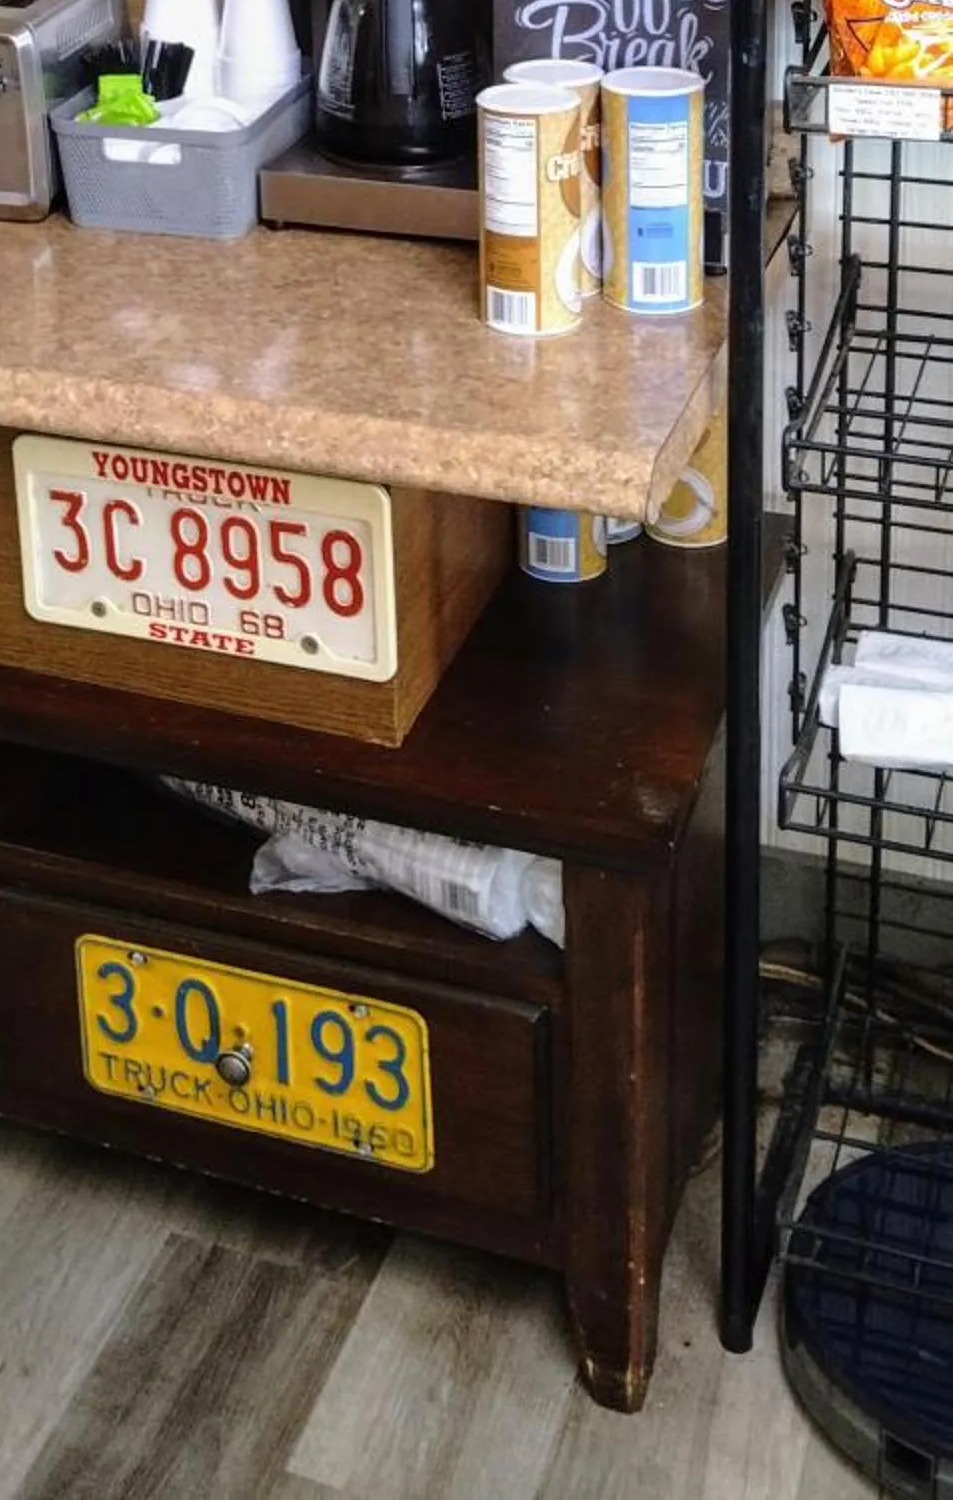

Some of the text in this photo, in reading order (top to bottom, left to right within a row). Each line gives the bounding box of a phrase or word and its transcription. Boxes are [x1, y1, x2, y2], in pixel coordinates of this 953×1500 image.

[91, 450, 292, 506] YOUNGSTOWN
[49, 489, 366, 619] 3C 8958
[131, 591, 287, 640] OHIO 68
[148, 621, 257, 656] STATE
